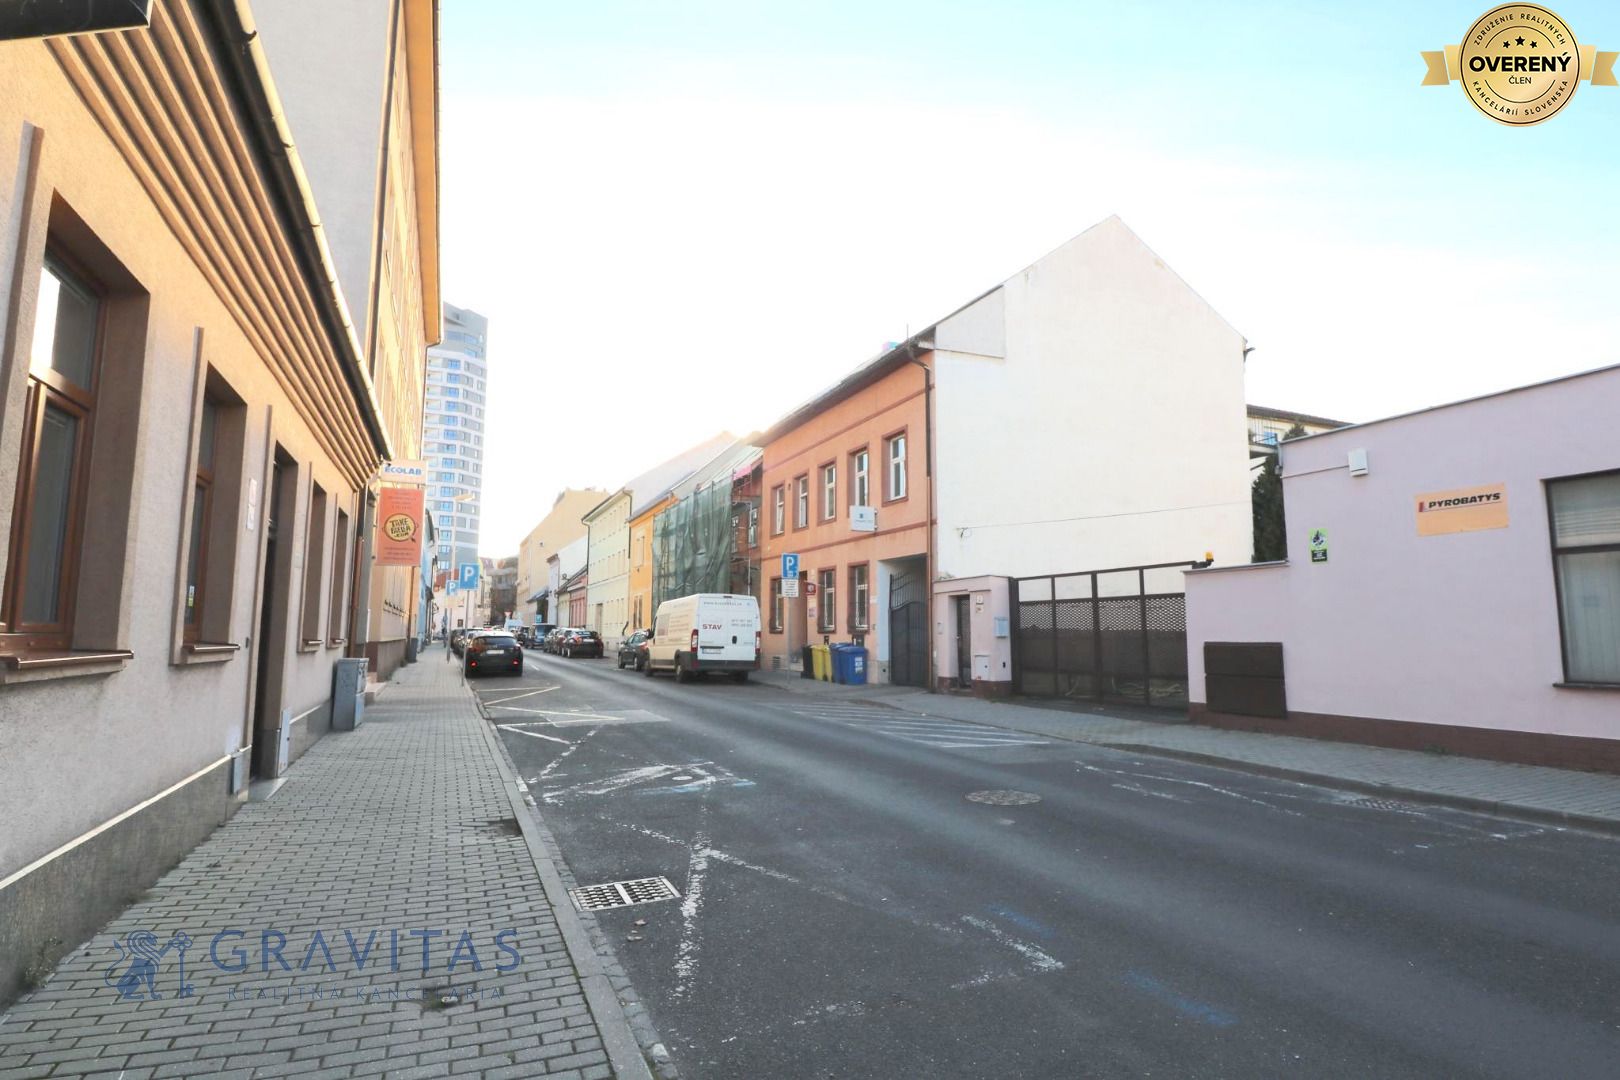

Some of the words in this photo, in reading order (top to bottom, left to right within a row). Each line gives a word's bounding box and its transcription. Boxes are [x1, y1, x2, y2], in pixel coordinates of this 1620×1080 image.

[384, 466, 422, 476] ECOLAB
[1428, 492, 1501, 509] PYROBATYS
[786, 556, 795, 572] P
[464, 566, 475, 582] P
[702, 623, 722, 631] STAV
